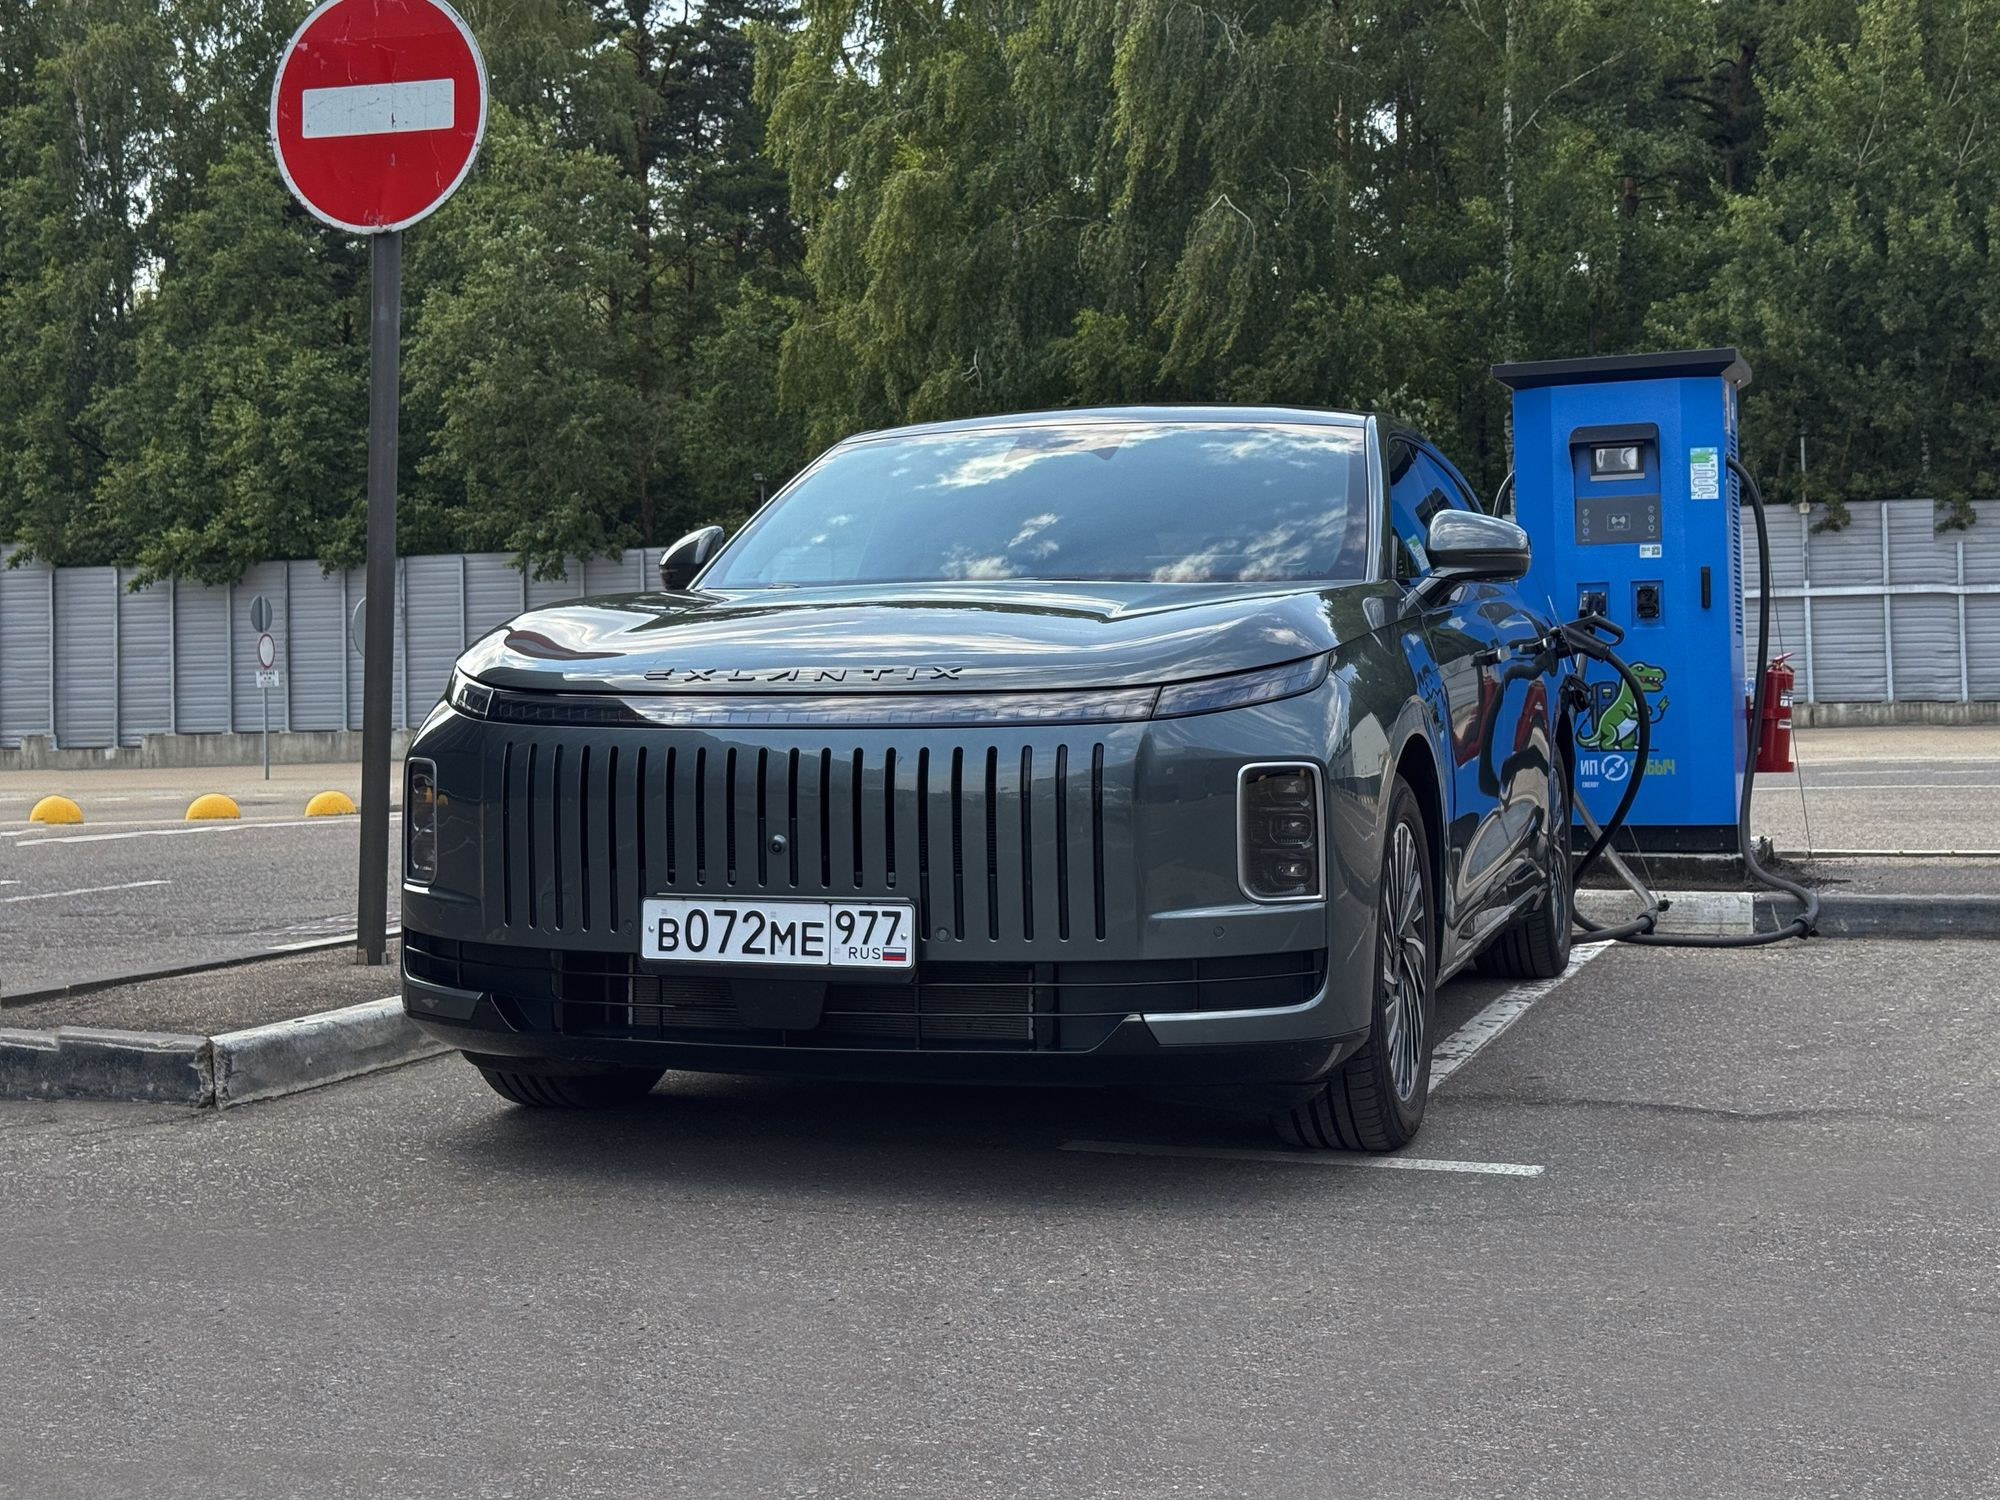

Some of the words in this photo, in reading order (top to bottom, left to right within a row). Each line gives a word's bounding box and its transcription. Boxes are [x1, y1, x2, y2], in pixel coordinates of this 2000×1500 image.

[643, 666, 963, 682] EXLANTIX
[1580, 759, 1598, 776] ИП
[835, 910, 902, 946] 977
[848, 946, 881, 960] RUS
